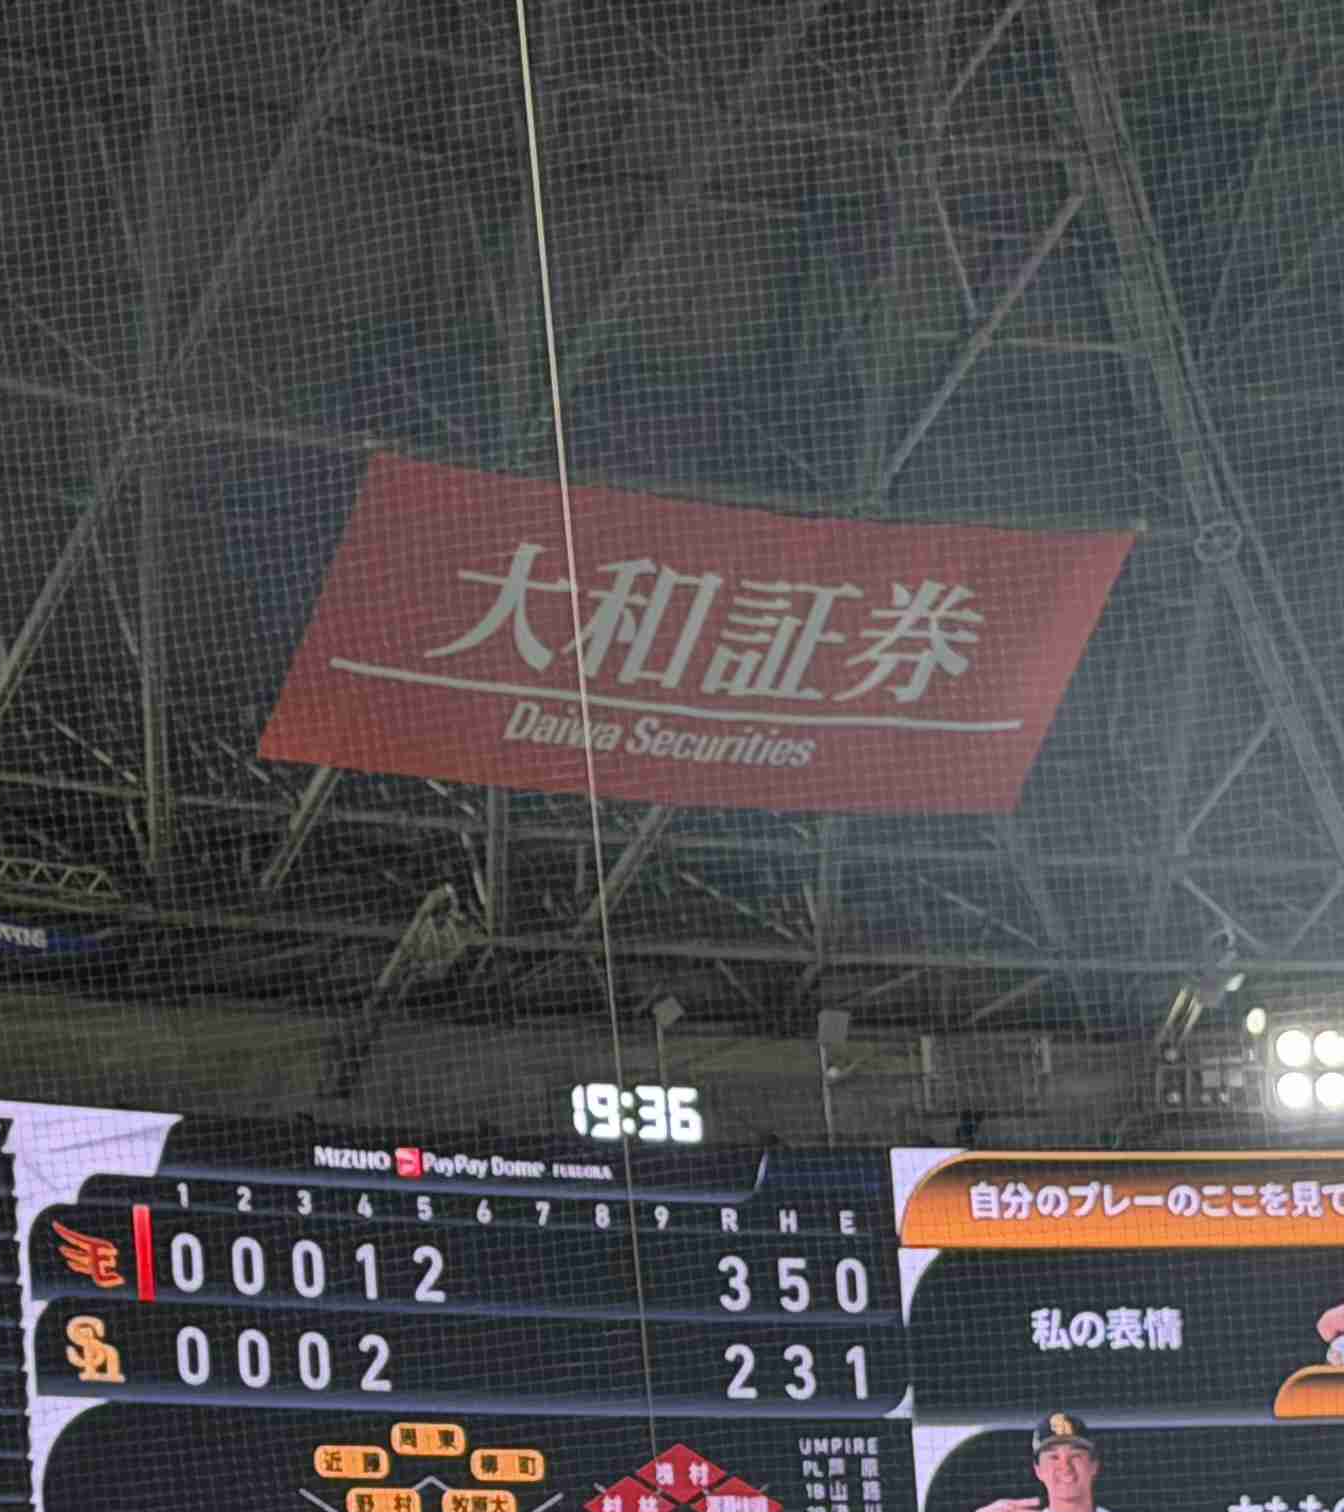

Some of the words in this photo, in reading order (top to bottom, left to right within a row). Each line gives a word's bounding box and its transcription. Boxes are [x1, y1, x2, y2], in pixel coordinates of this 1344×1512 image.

[424, 541, 985, 703] 大和証券
[503, 702, 622, 755] Daiwa
[624, 717, 816, 768] Securities
[571, 1083, 703, 1143] 19:36
[314, 1145, 391, 1170] MIZUHO
[171, 1232, 204, 1293] 0
[231, 1236, 265, 1297] 0
[292, 1240, 325, 1299] 0
[355, 1243, 378, 1300] 1
[413, 1245, 446, 1303] 2
[717, 1255, 751, 1312] 3
[777, 1257, 810, 1313] 5
[835, 1257, 869, 1314] 0
[1031, 1308, 1183, 1351] 私の表情
[176, 1326, 210, 1386] 0
[237, 1329, 271, 1388] 0
[298, 1331, 331, 1390] 0
[358, 1333, 392, 1392] 2
[724, 1343, 758, 1401] 2
[783, 1344, 817, 1401] 3
[845, 1345, 869, 1401] 1
[799, 1437, 879, 1455] UMPIRE
